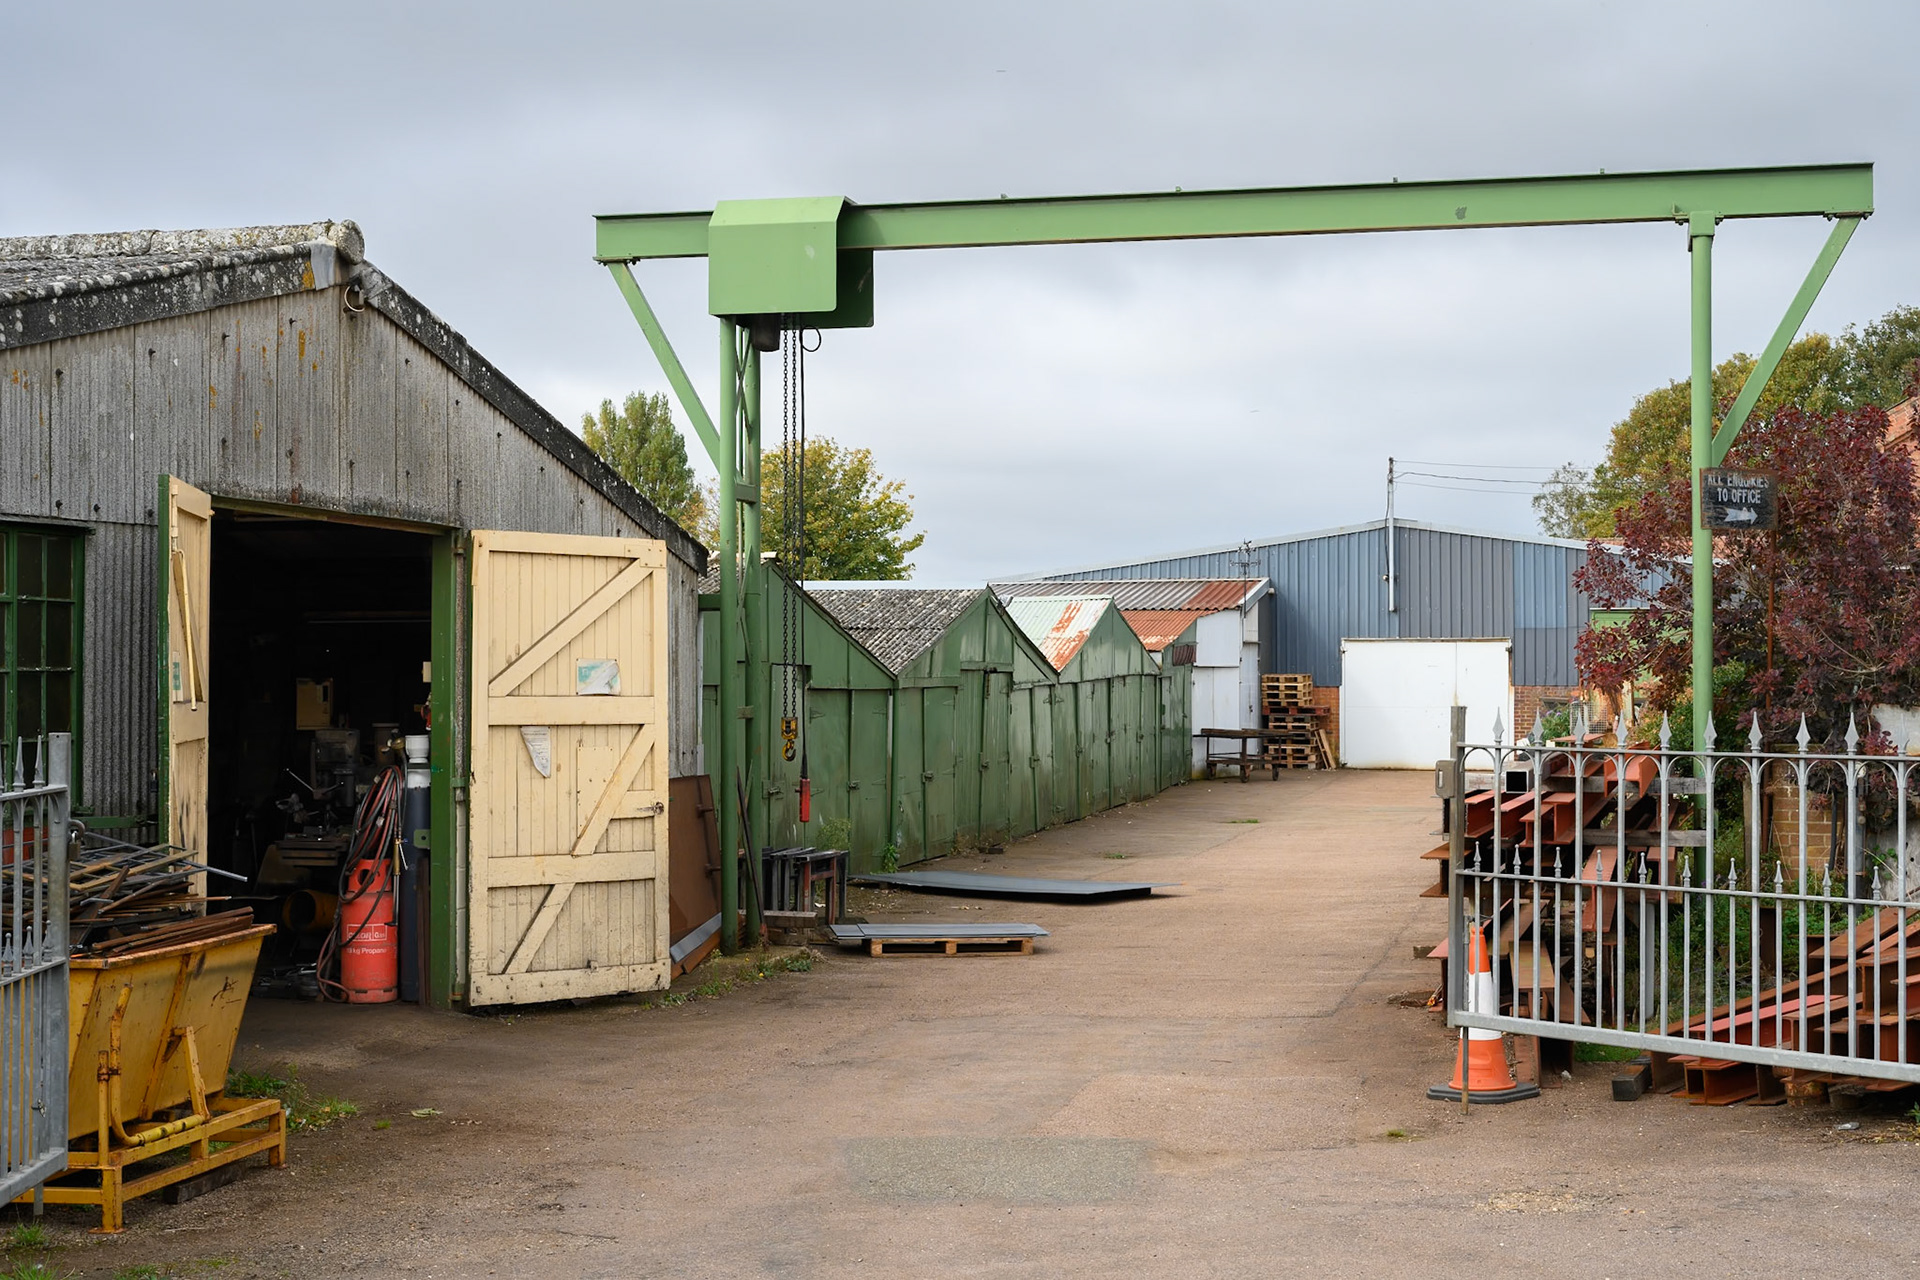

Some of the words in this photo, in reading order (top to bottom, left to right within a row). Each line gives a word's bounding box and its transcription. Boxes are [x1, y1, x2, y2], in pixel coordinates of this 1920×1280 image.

[1708, 474, 1723, 486] ALL
[1717, 487, 1728, 502] TO
[1731, 488, 1761, 504] OFFICE
[348, 932, 371, 940] CLOR
